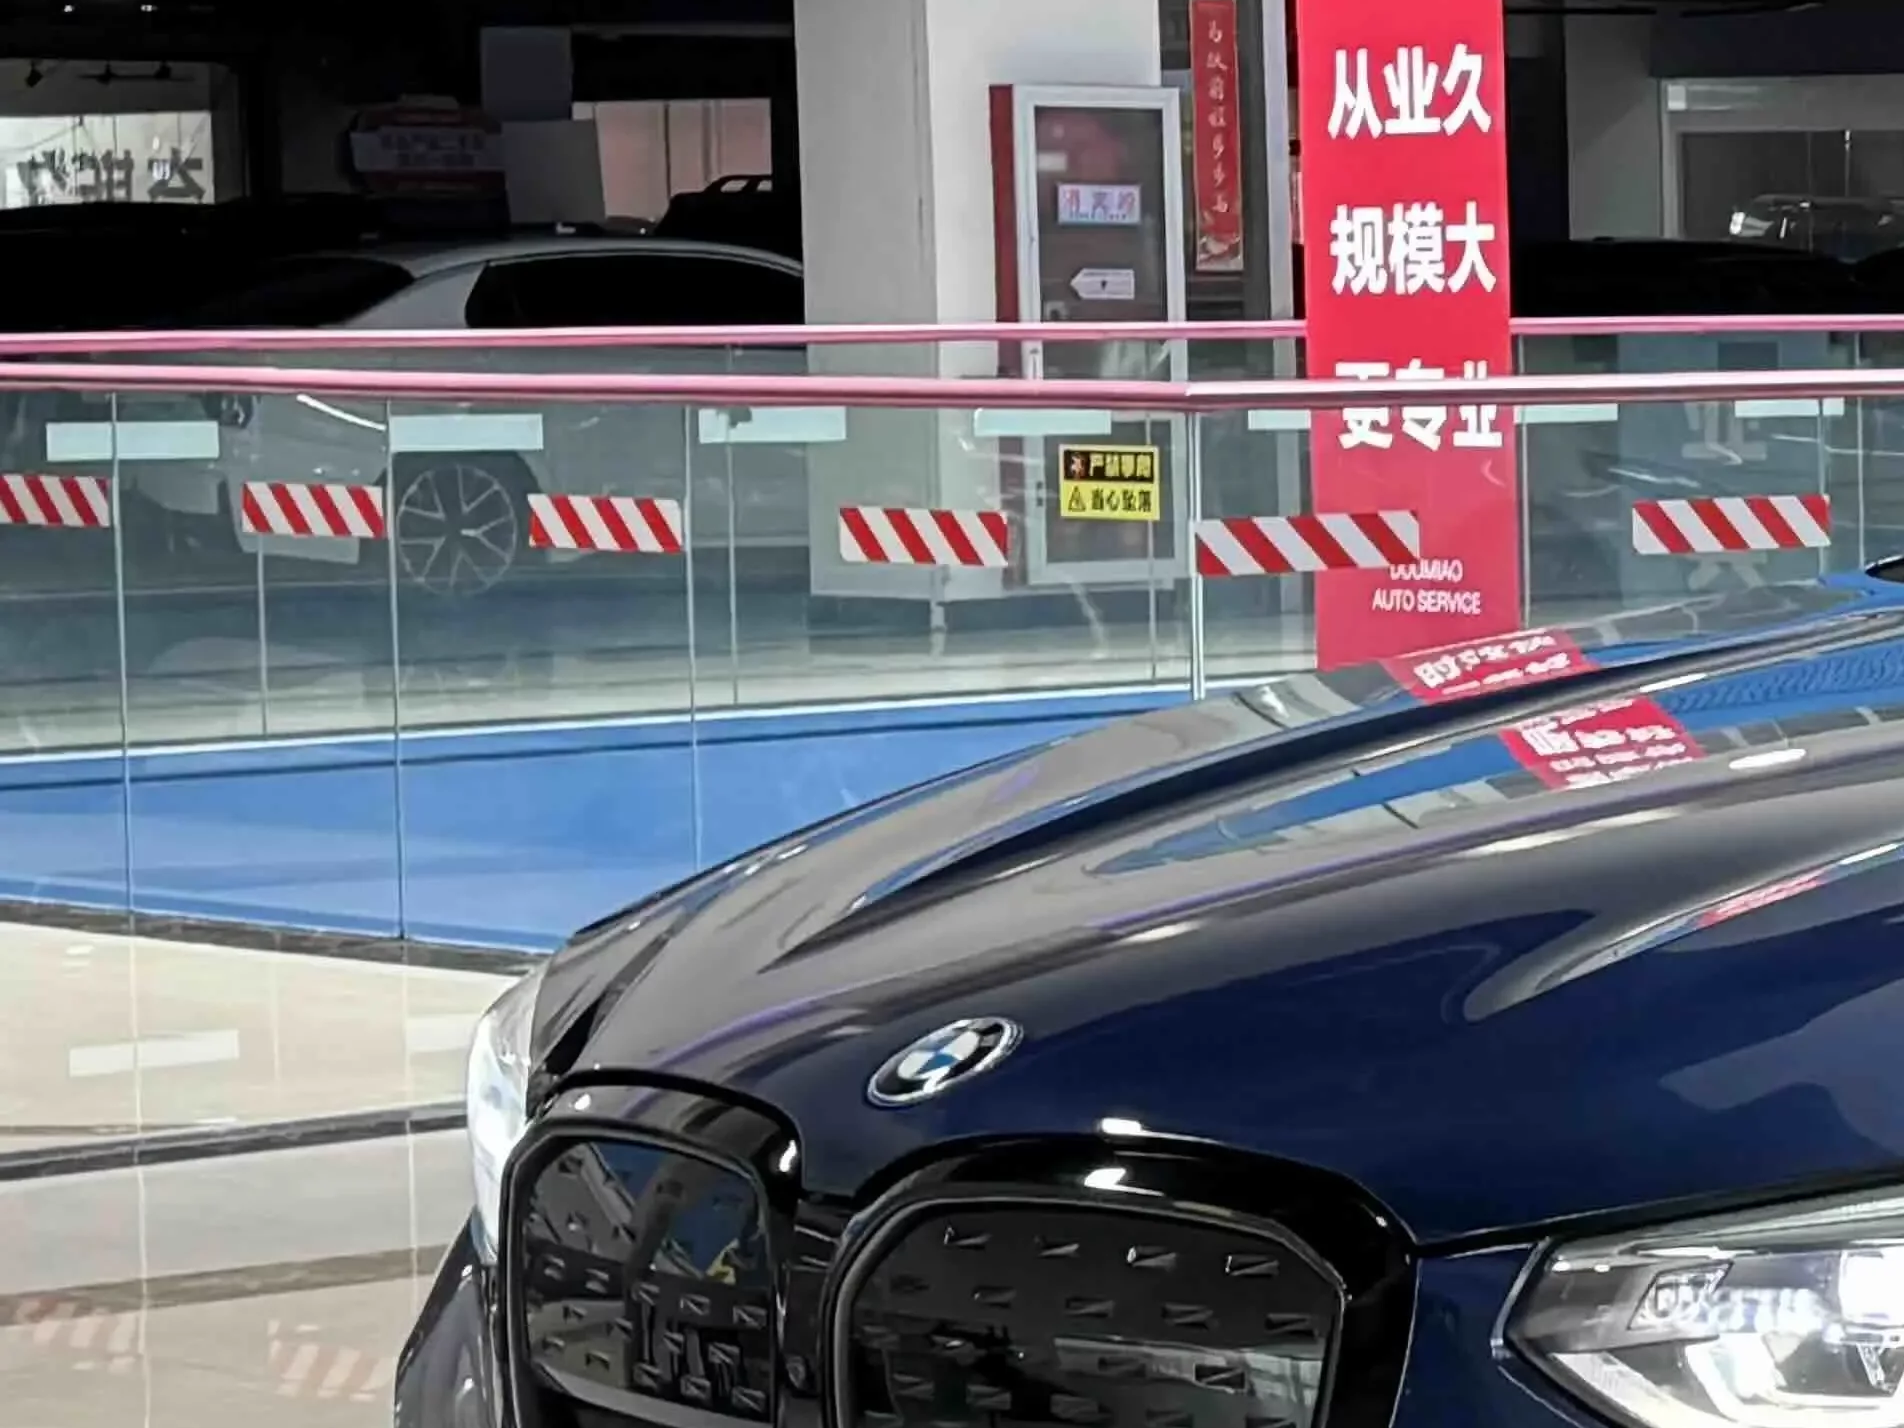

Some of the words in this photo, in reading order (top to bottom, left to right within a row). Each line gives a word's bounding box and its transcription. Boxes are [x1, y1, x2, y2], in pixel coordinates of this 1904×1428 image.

[1328, 43, 1492, 139] 从业久
[1329, 201, 1497, 295] 规模大
[1335, 359, 1503, 450] 更专业
[1372, 588, 1415, 612] AUTO
[1416, 589, 1481, 614] SERVICE
